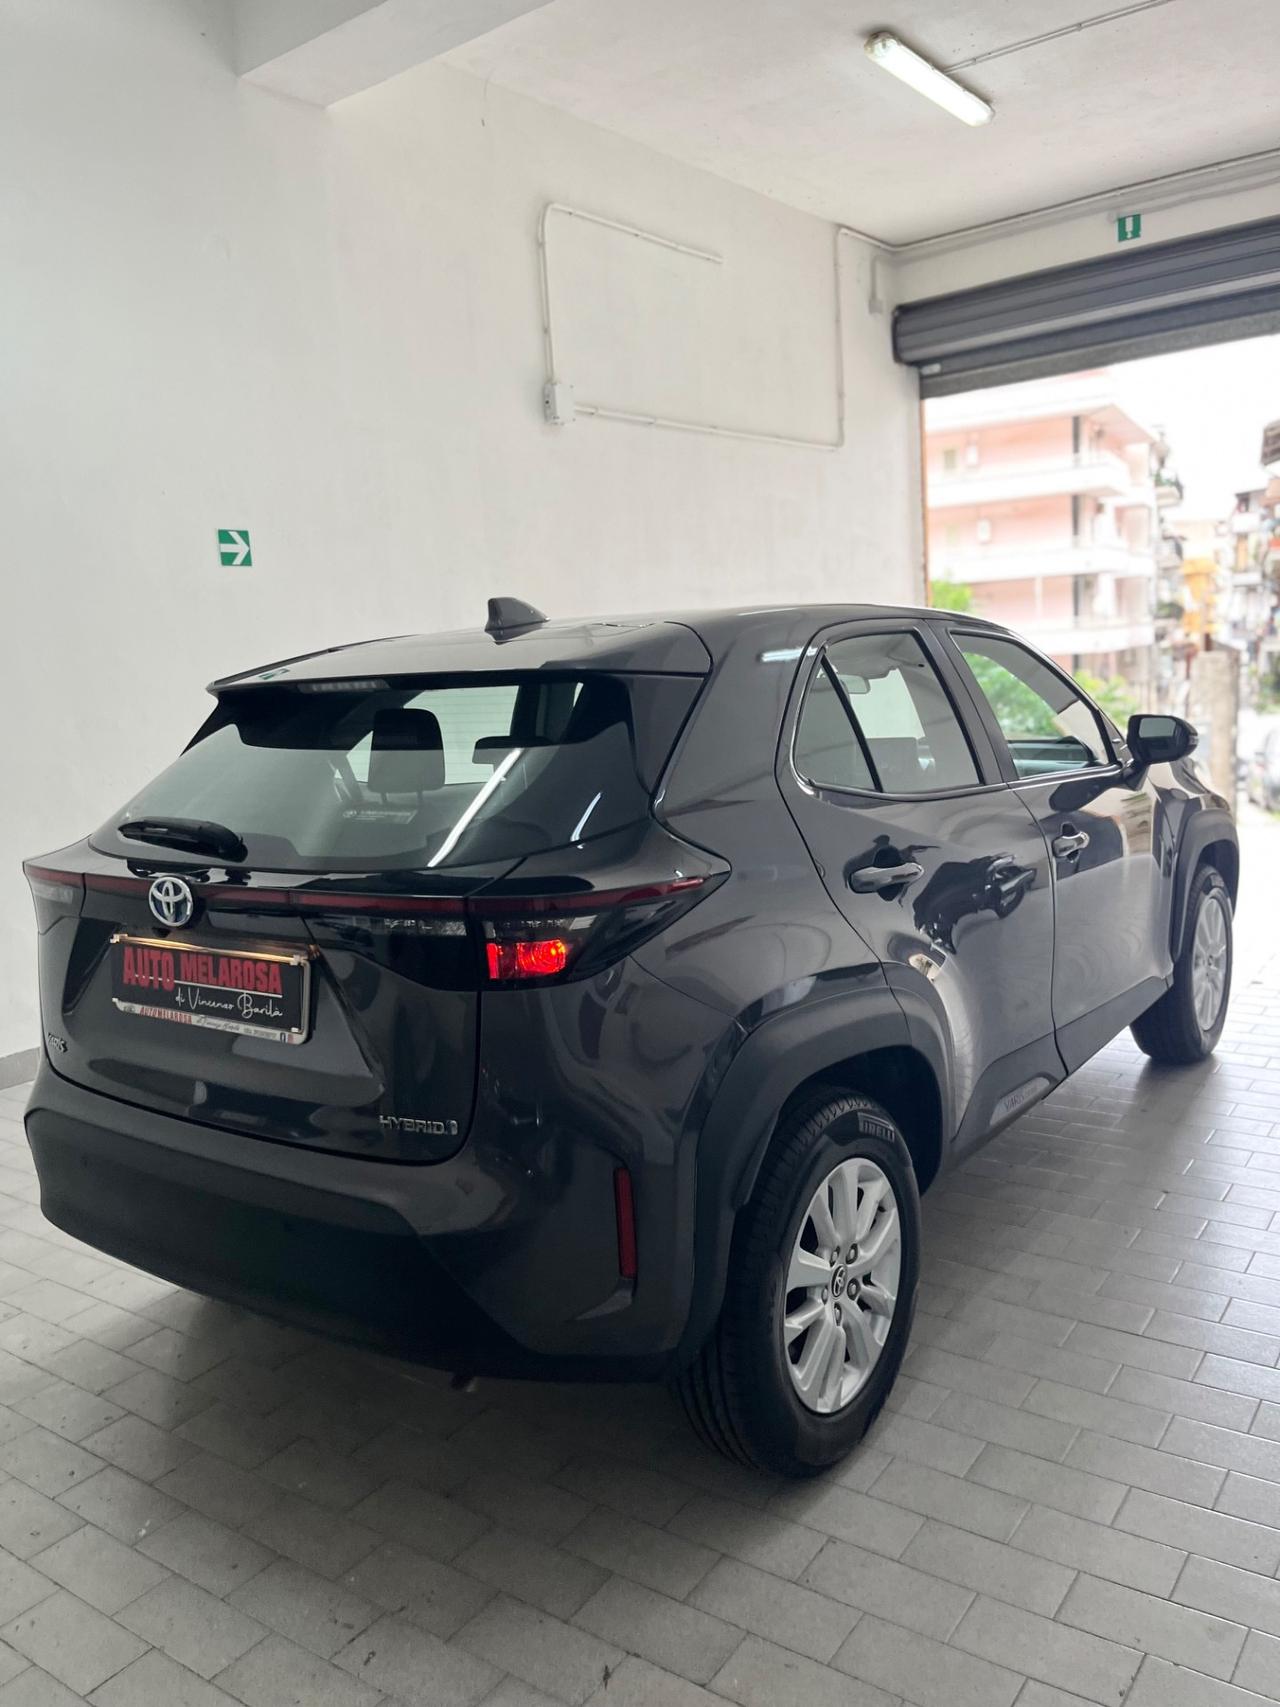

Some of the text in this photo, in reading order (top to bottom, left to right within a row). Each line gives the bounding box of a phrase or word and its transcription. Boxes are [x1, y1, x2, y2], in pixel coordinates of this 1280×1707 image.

[122, 945, 283, 995] AUTO MELAROSA
[175, 987, 185, 1007] di
[188, 987, 235, 1010] Vincenzo
[379, 1115, 445, 1135] HYBRID
